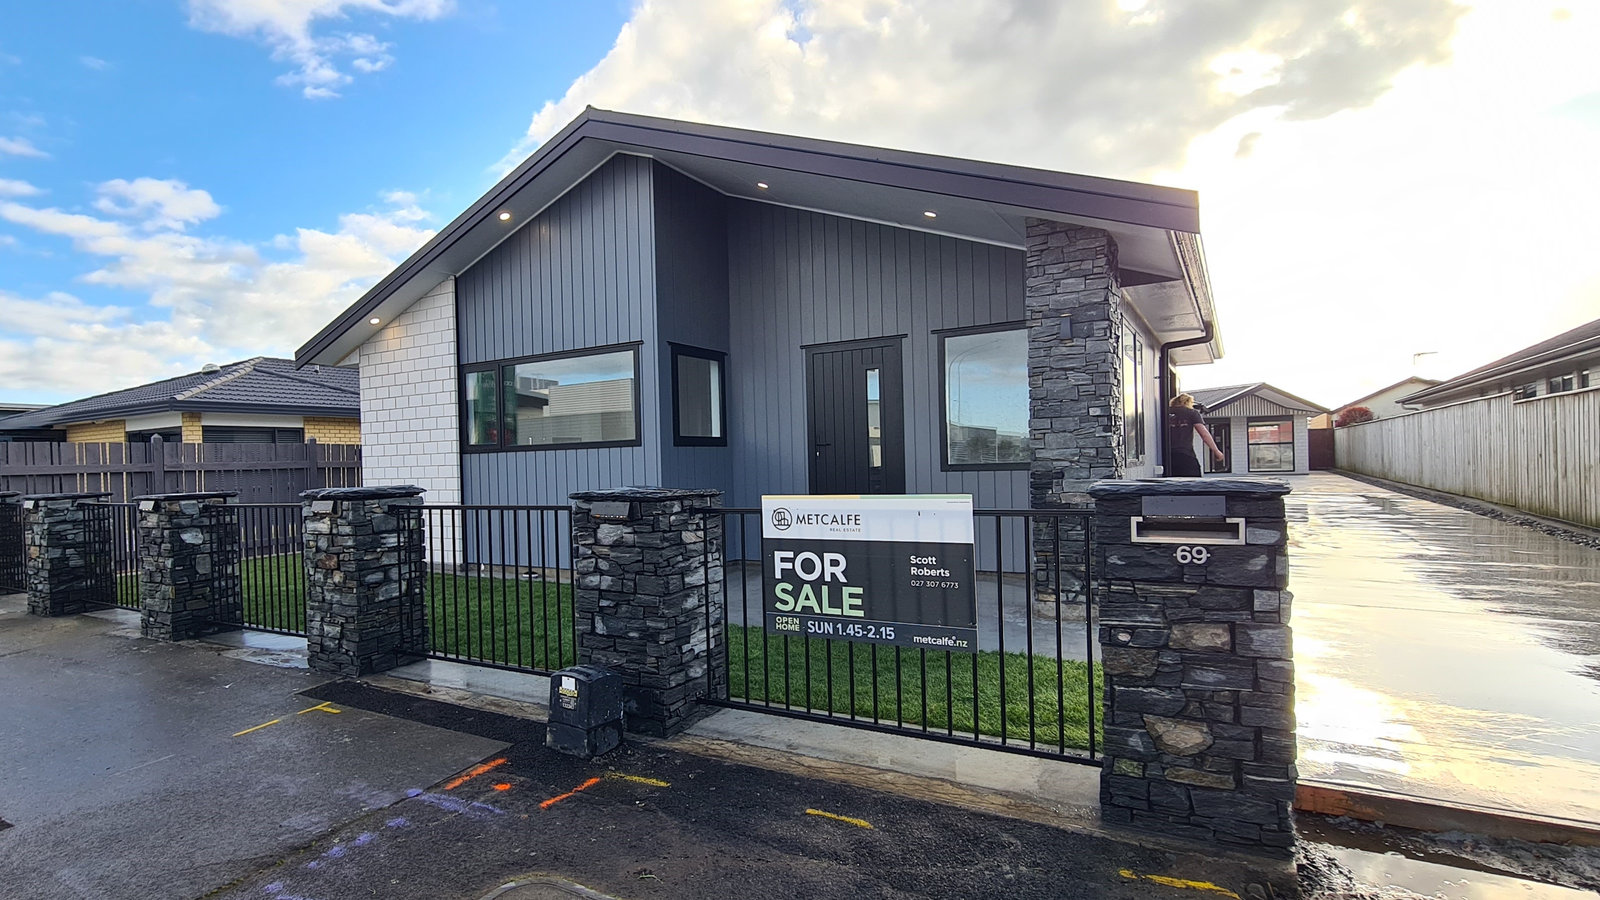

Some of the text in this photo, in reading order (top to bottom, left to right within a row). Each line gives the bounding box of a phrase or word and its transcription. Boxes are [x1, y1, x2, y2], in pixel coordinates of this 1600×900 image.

[796, 513, 861, 526] METCALFE
[910, 555, 936, 565] Scott
[1176, 546, 1208, 564] 69
[773, 550, 848, 583] FOR
[910, 566, 950, 577] Roberts
[926, 580, 939, 588] 307
[941, 581, 959, 589] 6773
[774, 582, 865, 617] SALE
[775, 616, 800, 624] OPEN
[775, 623, 800, 631] HOME
[807, 620, 895, 640] SUN 1.45-2.15
[913, 635, 968, 648] metcalfe.nz
